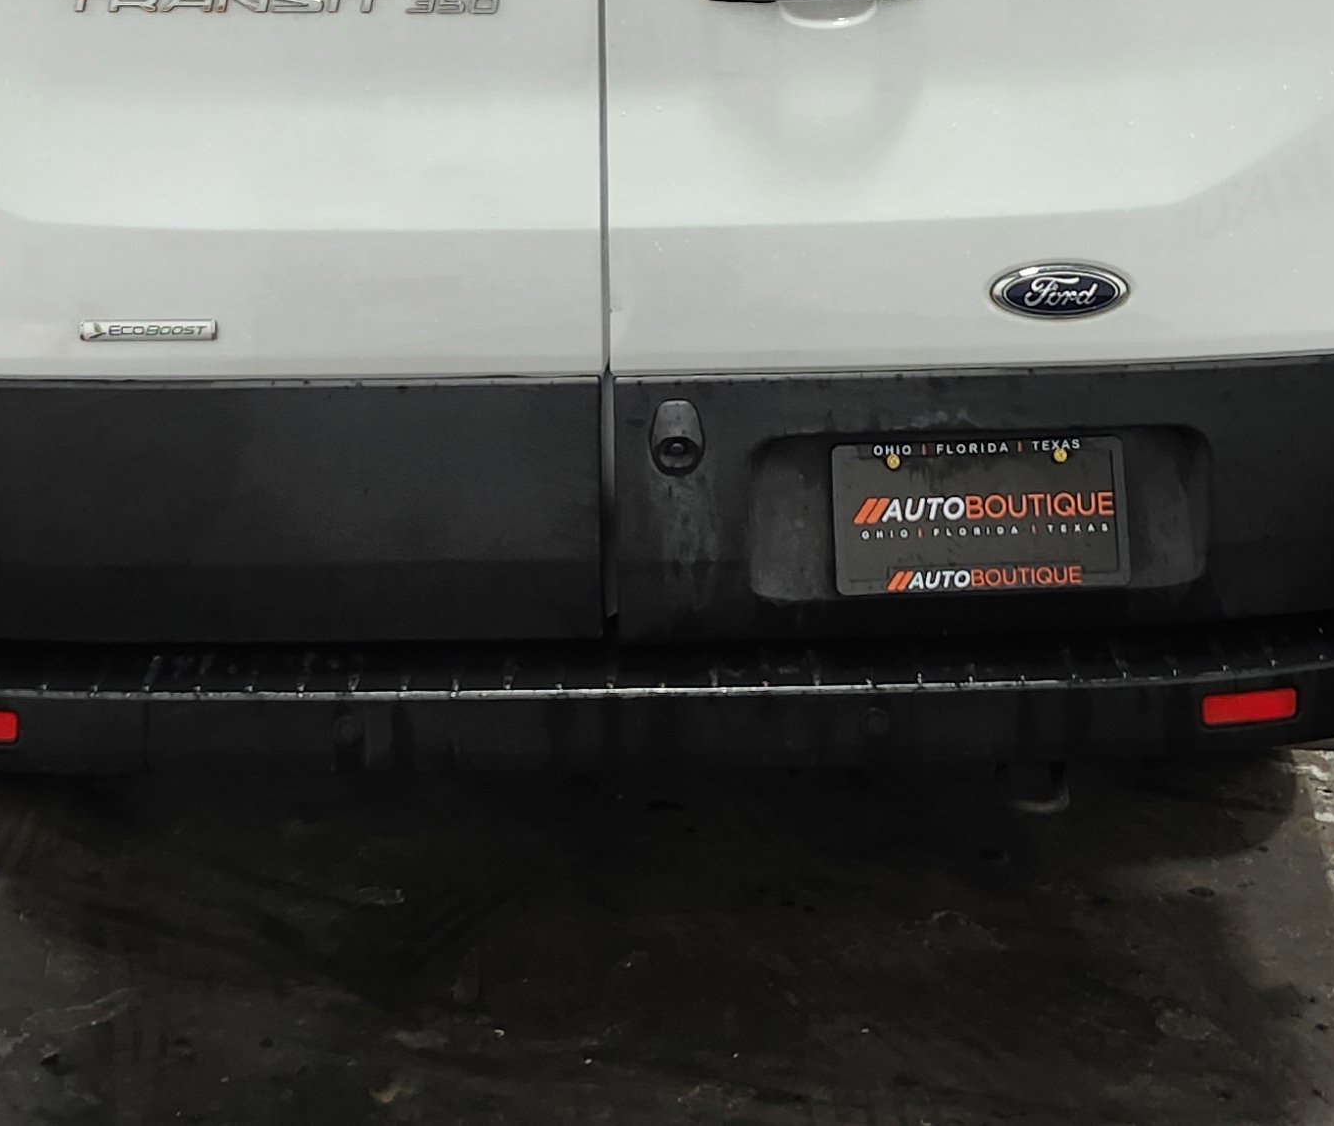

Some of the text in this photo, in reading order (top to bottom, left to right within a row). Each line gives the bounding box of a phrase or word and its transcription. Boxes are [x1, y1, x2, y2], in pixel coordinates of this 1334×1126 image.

[1024, 276, 1098, 308] Ford
[873, 438, 1081, 457] OHIO FLORIDA TEXAS
[881, 491, 1115, 523] AUTOBOUTIQUE
[861, 522, 1109, 540] OHIO FLORIDA TEXAS
[908, 565, 1083, 590] AUTOBOUTIQUE
